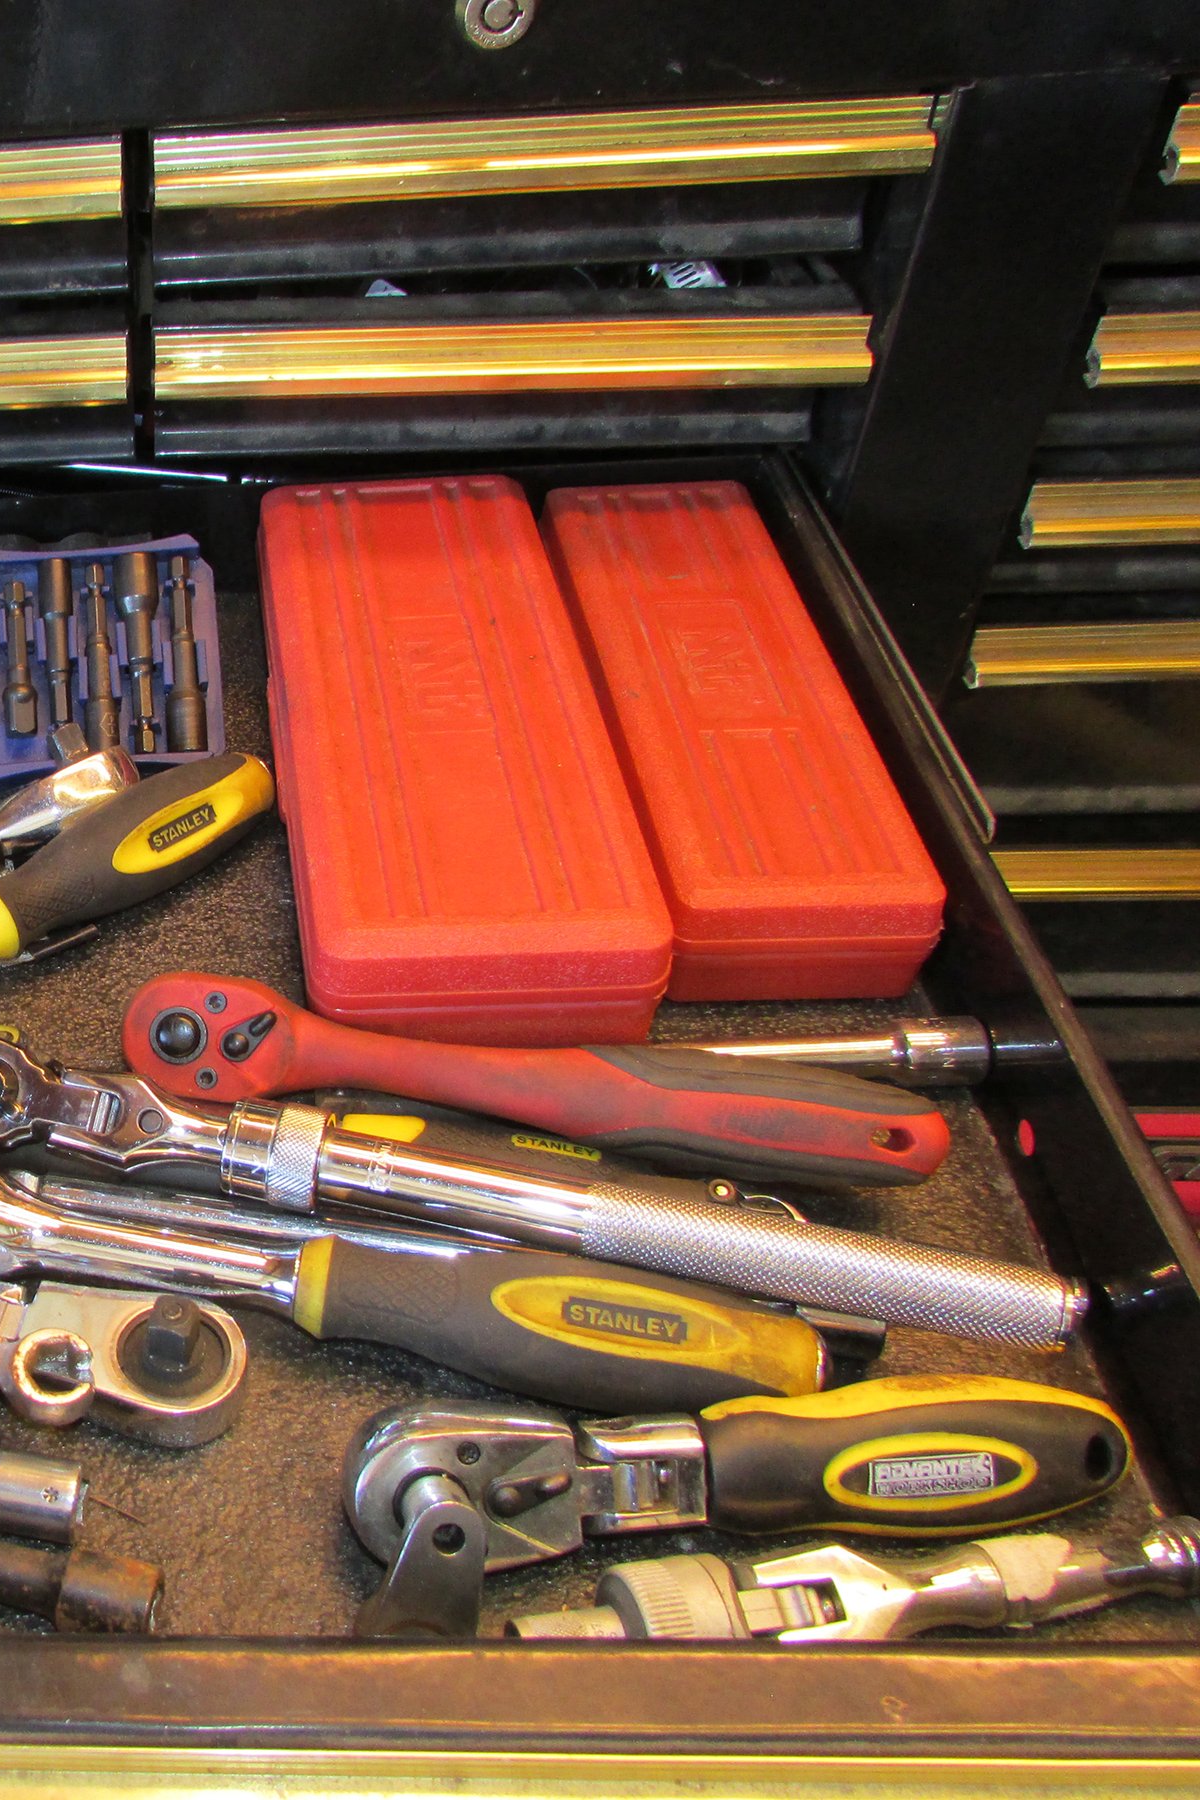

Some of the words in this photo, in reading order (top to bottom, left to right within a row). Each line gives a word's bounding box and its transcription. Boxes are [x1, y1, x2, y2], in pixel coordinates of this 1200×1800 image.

[152, 808, 211, 848] STANLEY
[516, 1135, 597, 1157] STANLEY
[569, 1303, 680, 1338] STANLEY
[874, 1453, 991, 1483] ADVANTEK
